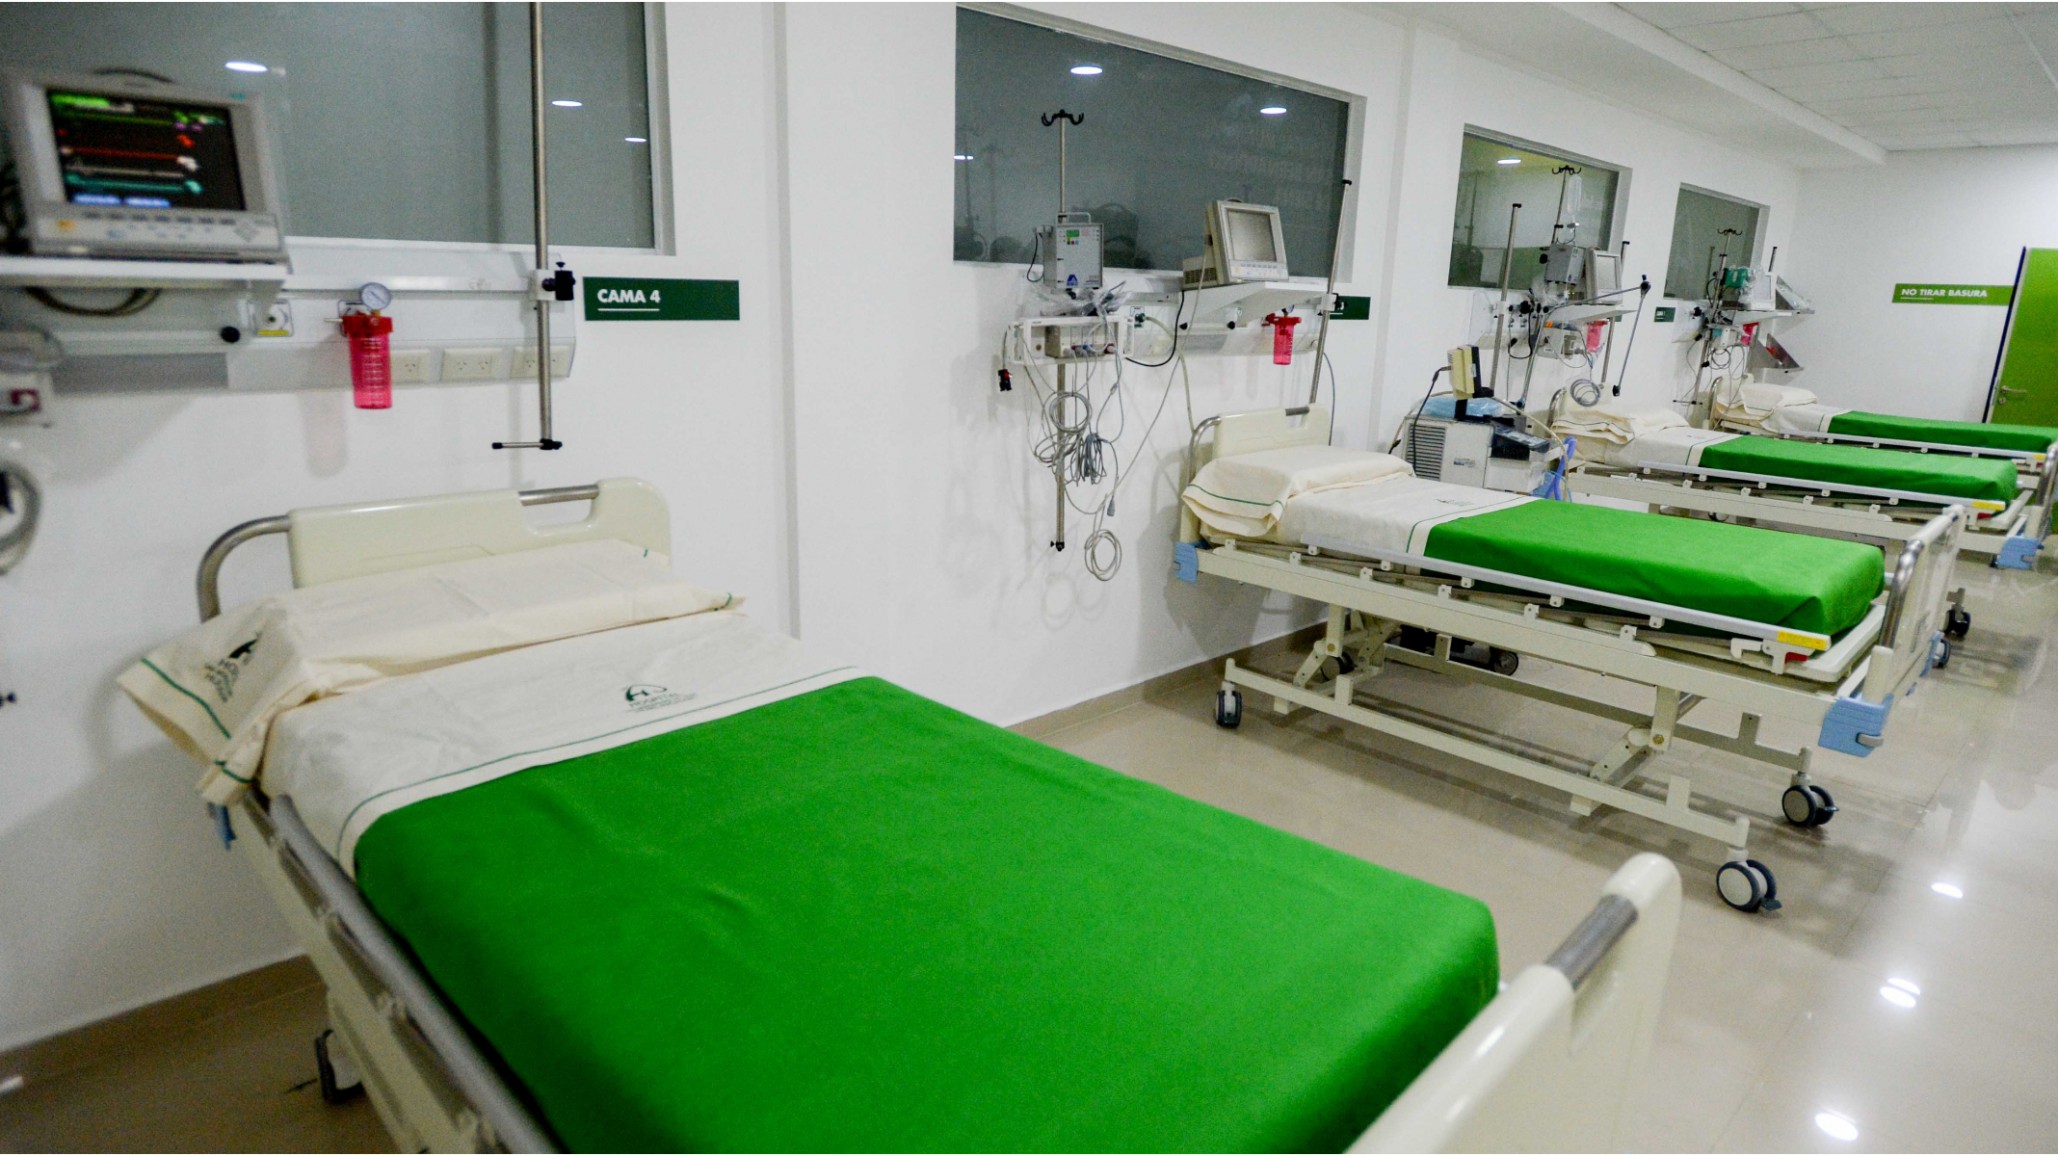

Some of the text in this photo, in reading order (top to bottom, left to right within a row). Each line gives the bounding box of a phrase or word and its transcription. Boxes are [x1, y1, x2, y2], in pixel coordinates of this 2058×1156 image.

[597, 289, 661, 304] CAMA 4
[1901, 288, 1988, 298] NO TIRAR BASURA
